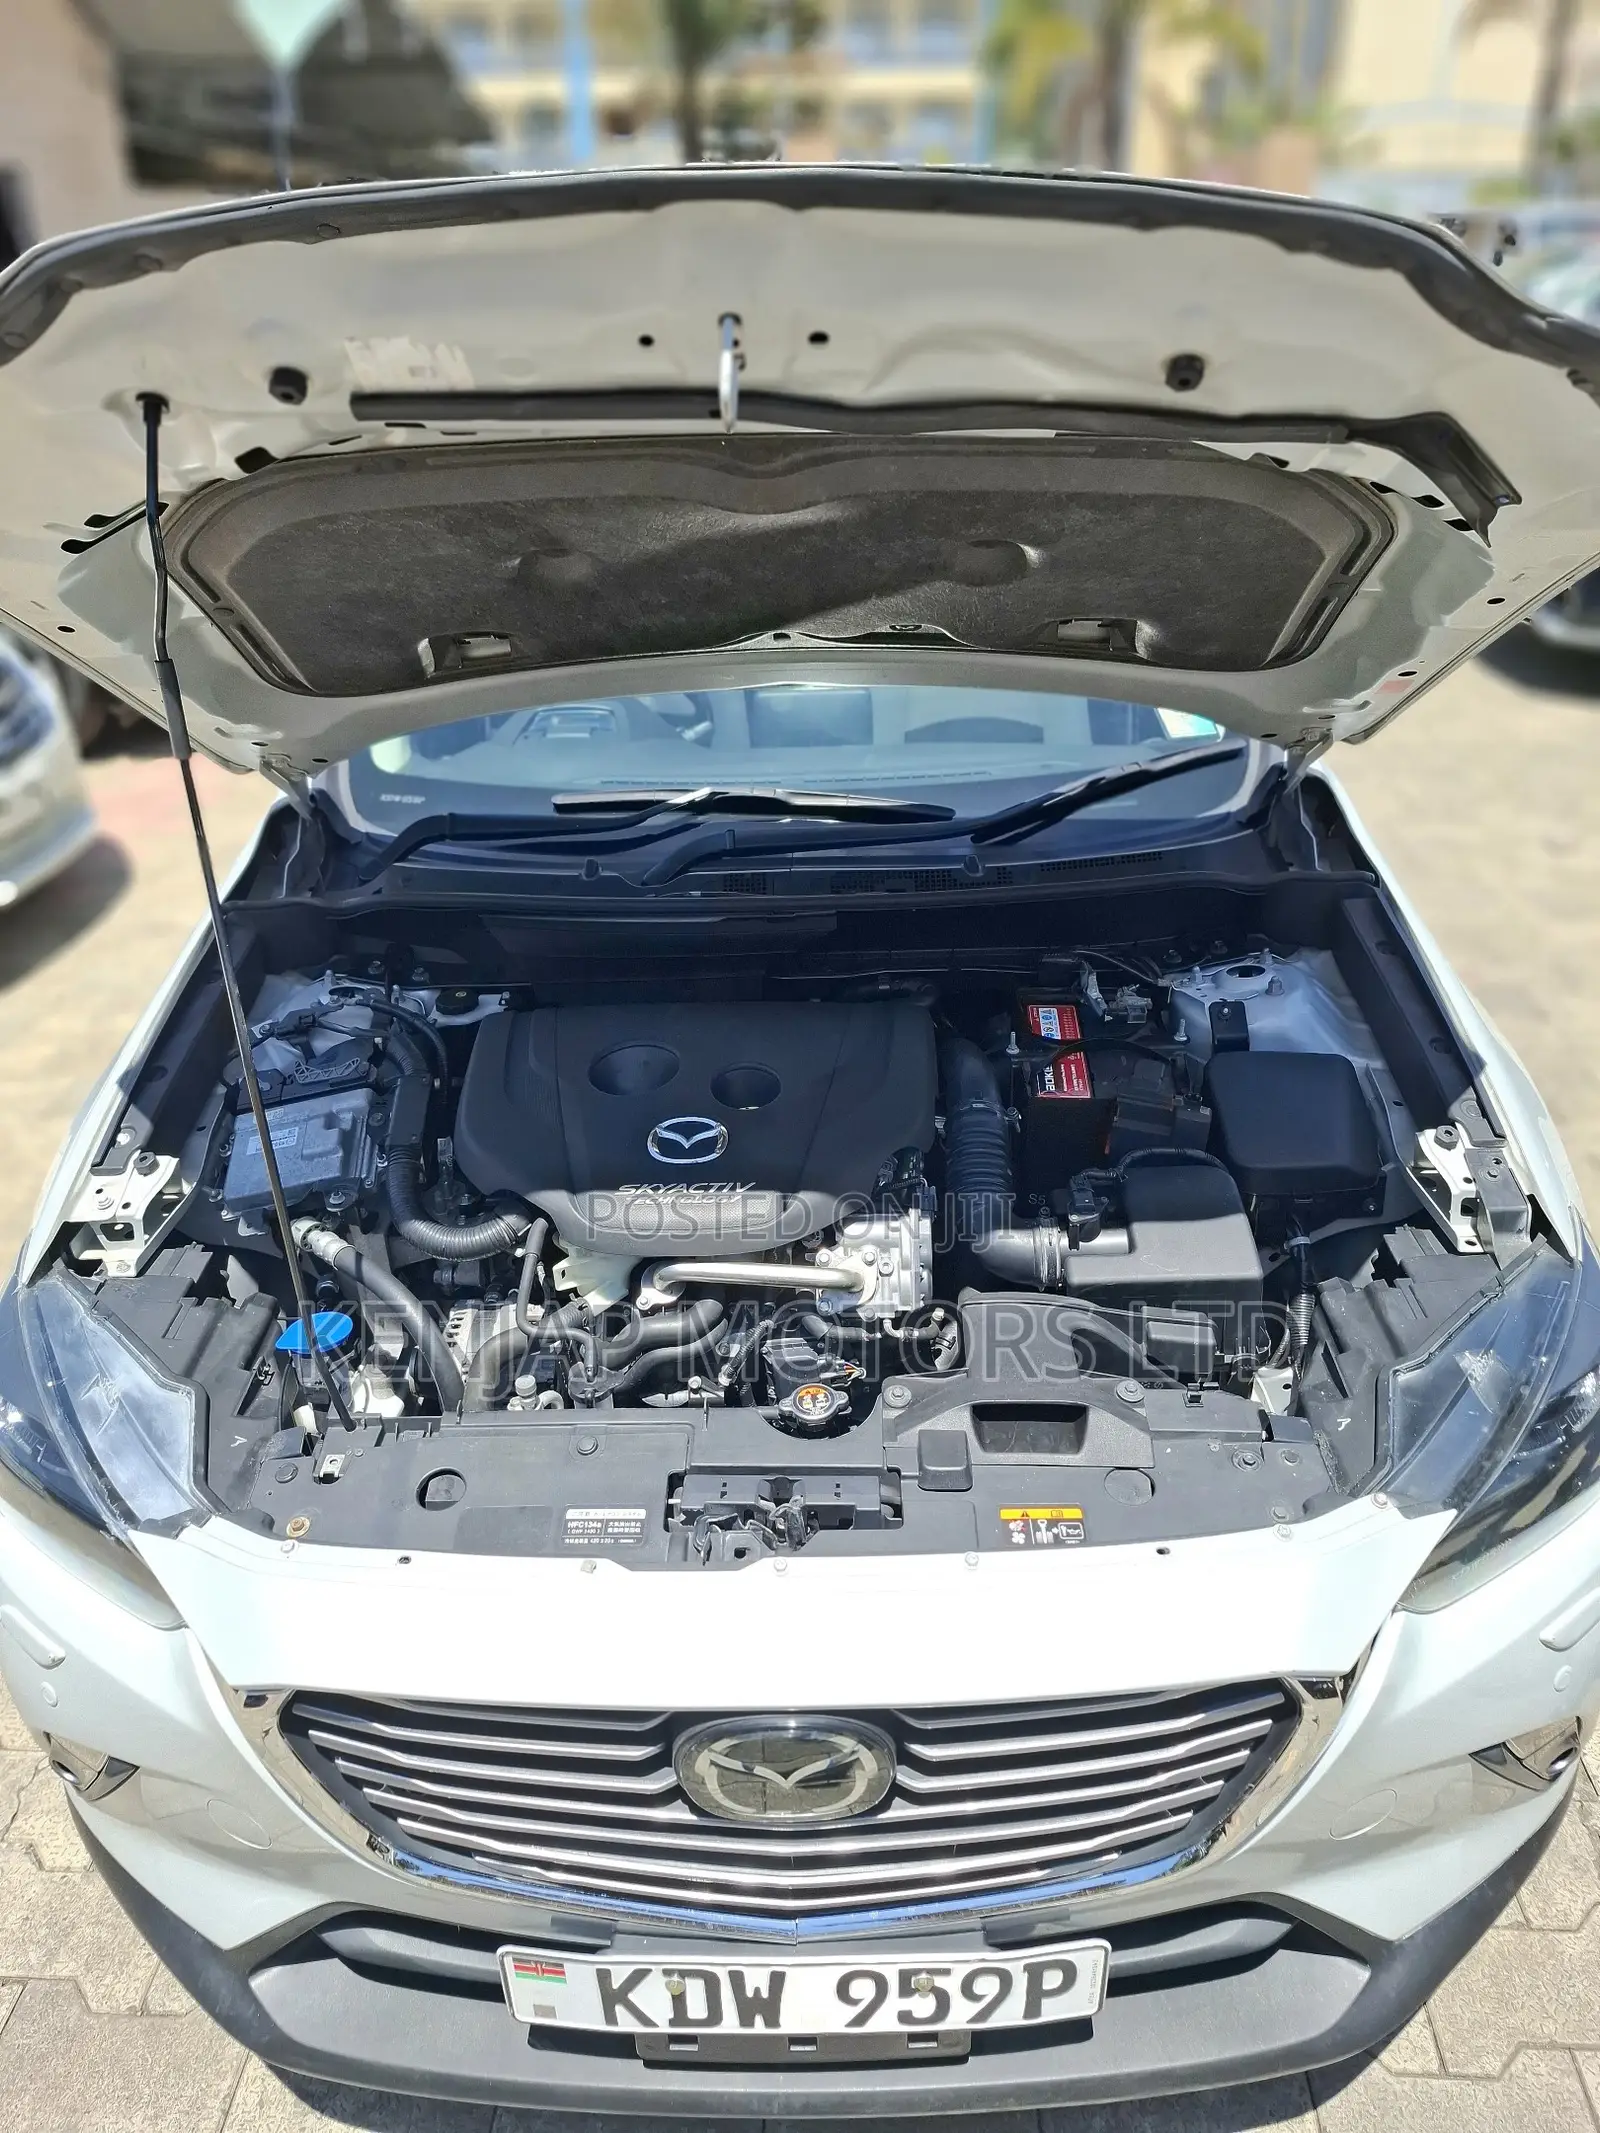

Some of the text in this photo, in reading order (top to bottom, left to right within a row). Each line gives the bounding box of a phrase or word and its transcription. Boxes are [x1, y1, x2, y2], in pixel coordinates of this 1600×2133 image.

[614, 1181, 756, 1196] SKYACTIV
[625, 1194, 742, 1206] TECHNOLOGY
[595, 1966, 788, 2029] KDW
[836, 1957, 1078, 2029] 959P
